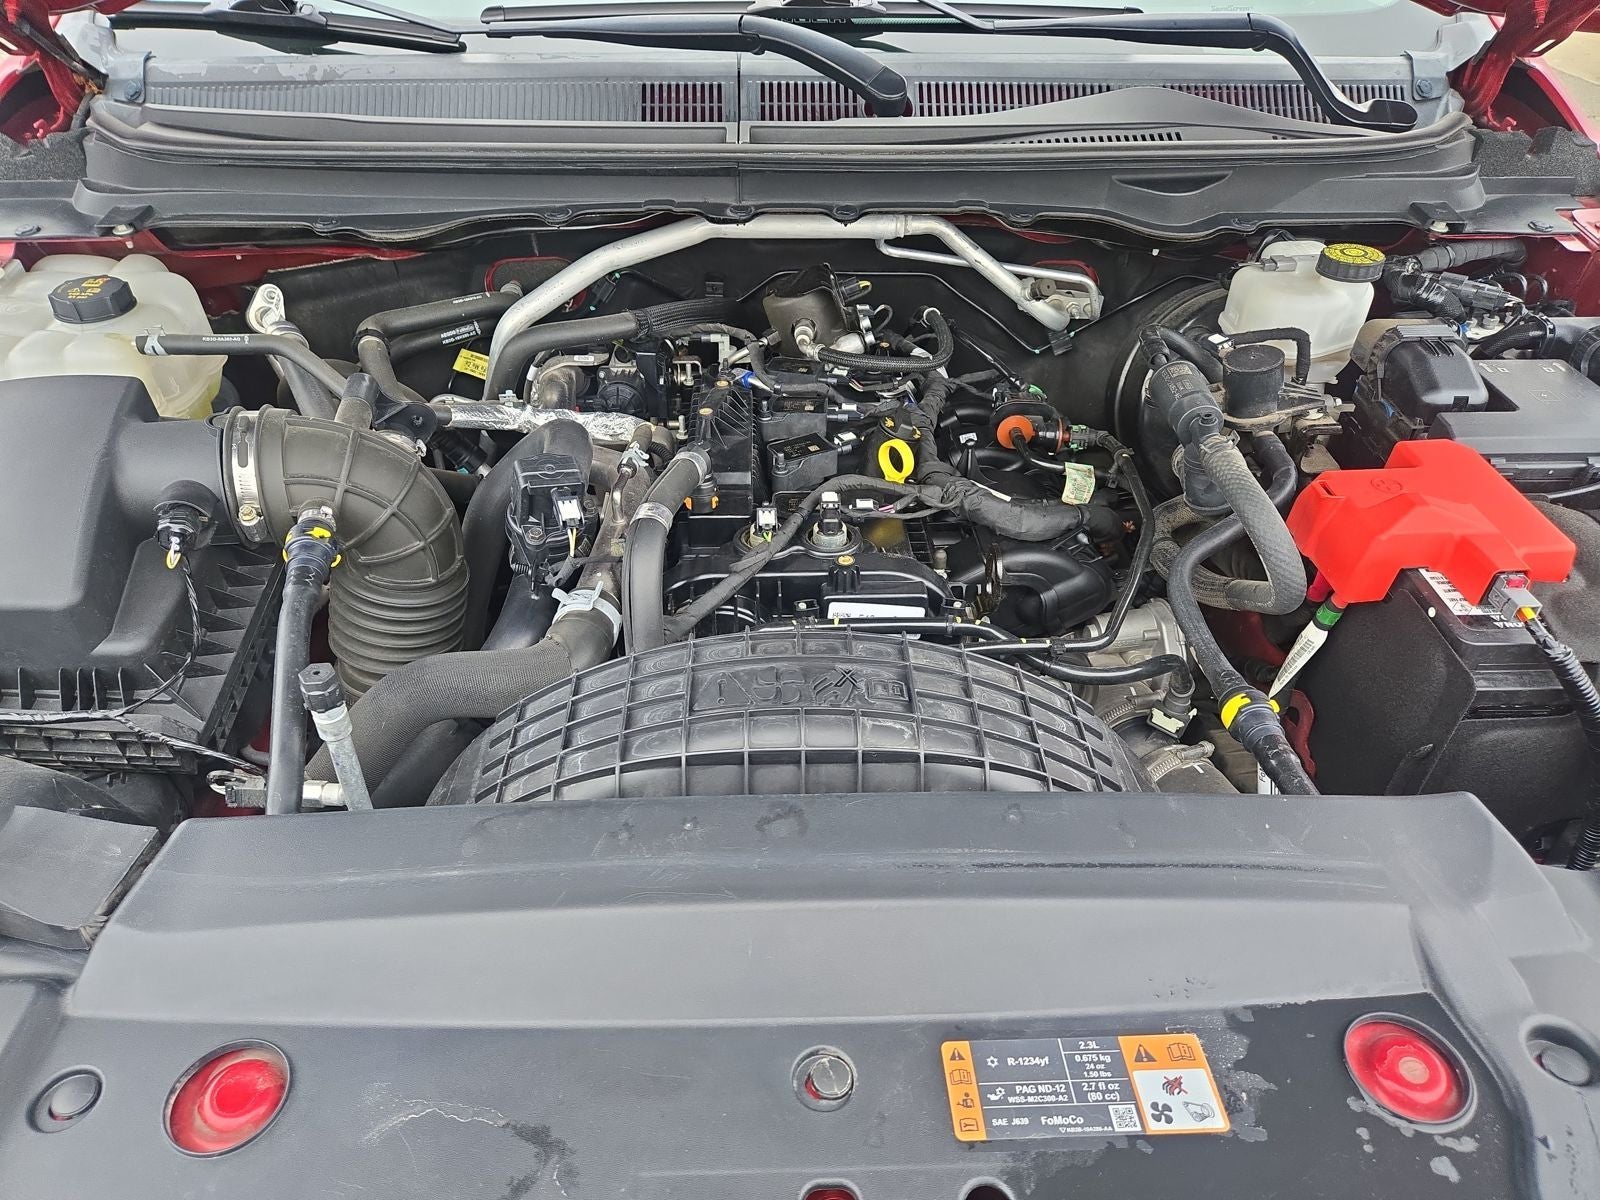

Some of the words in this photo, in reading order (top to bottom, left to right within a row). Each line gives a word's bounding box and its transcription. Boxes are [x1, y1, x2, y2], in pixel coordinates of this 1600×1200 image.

[1078, 1041, 1100, 1050] 2.3L
[1007, 1056, 1049, 1067] R-1234yf
[1074, 1054, 1098, 1063] 0.675
[1098, 1053, 1112, 1063] kg
[1015, 1084, 1037, 1094] PAG
[1037, 1083, 1067, 1093] ND-12
[1081, 1082, 1096, 1091] 2.7
[1097, 1081, 1106, 1091] fl
[1087, 1091, 1104, 1103] (80
[1104, 1090, 1120, 1102] cc)
[992, 1118, 1009, 1127] SAE
[1011, 1117, 1030, 1126] J639
[1040, 1115, 1085, 1126] FoMoCo
